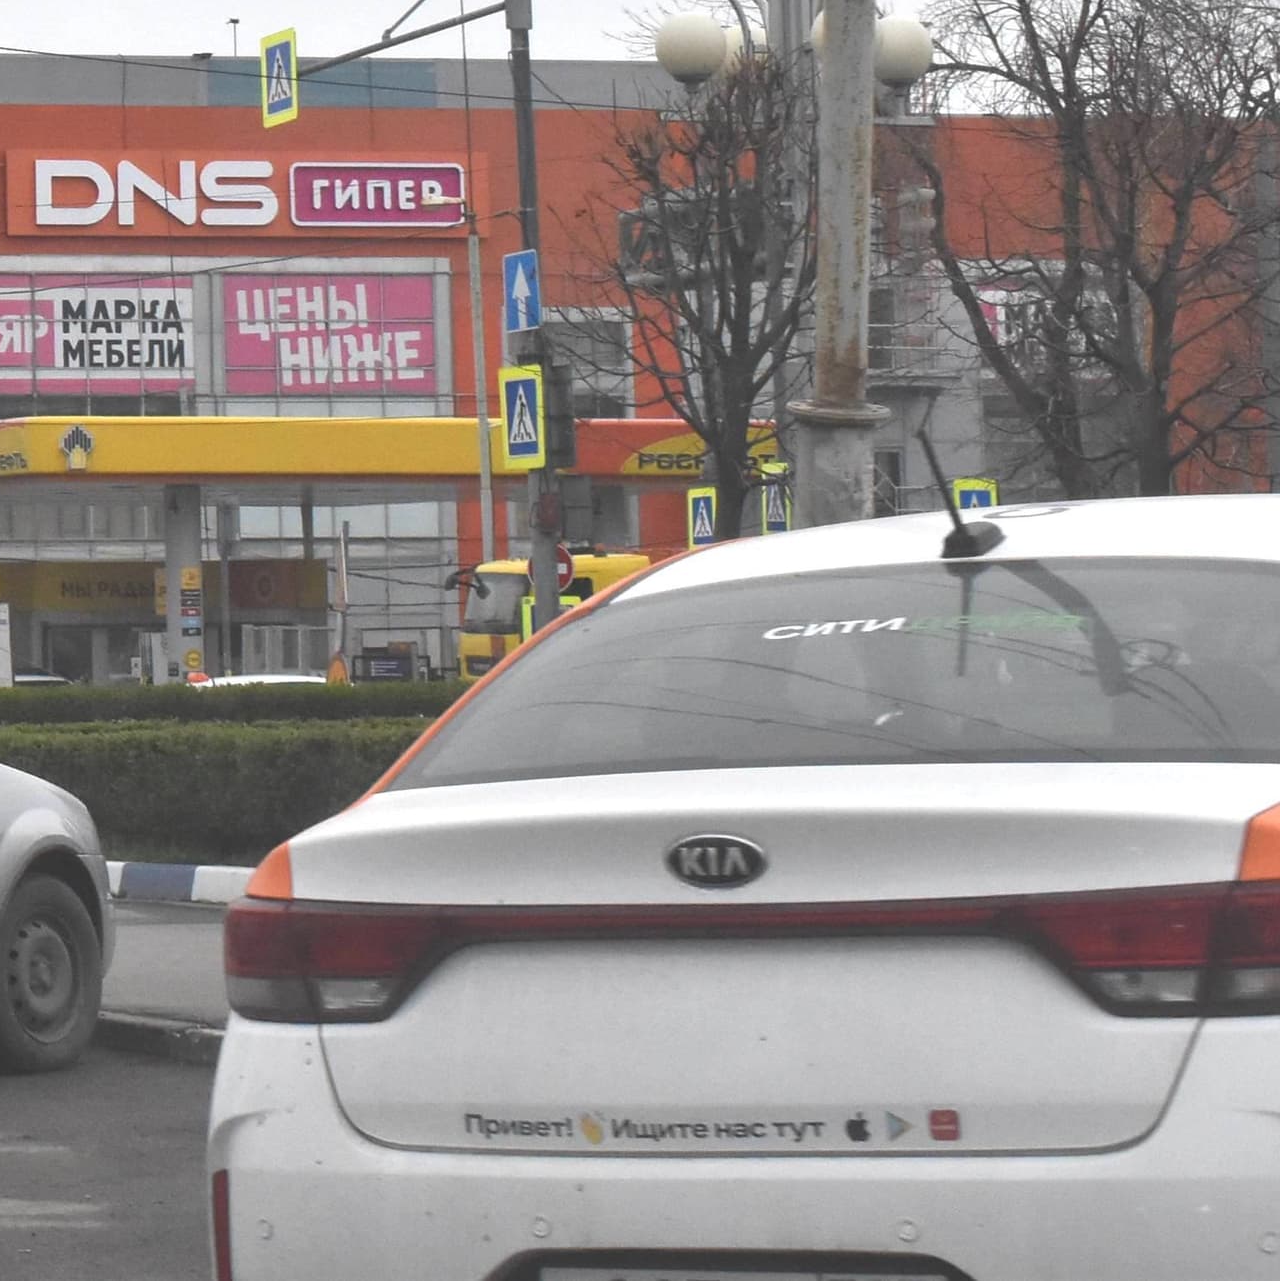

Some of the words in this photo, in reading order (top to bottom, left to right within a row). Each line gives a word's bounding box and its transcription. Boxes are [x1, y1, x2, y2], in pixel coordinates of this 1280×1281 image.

[35, 160, 279, 226] DNS
[312, 179, 444, 210] ГИПЕР
[62, 299, 184, 335] МАРКА
[236, 284, 369, 341] ЦЕНЫ
[62, 339, 186, 368] МЕБЕЛИ
[279, 331, 426, 386] НИЖЕ
[679, 846, 749, 876] KIA
[464, 1113, 574, 1139] Привет!
[610, 1118, 710, 1142] Ищите
[713, 1123, 767, 1138] нас
[772, 1121, 827, 1142] тут
